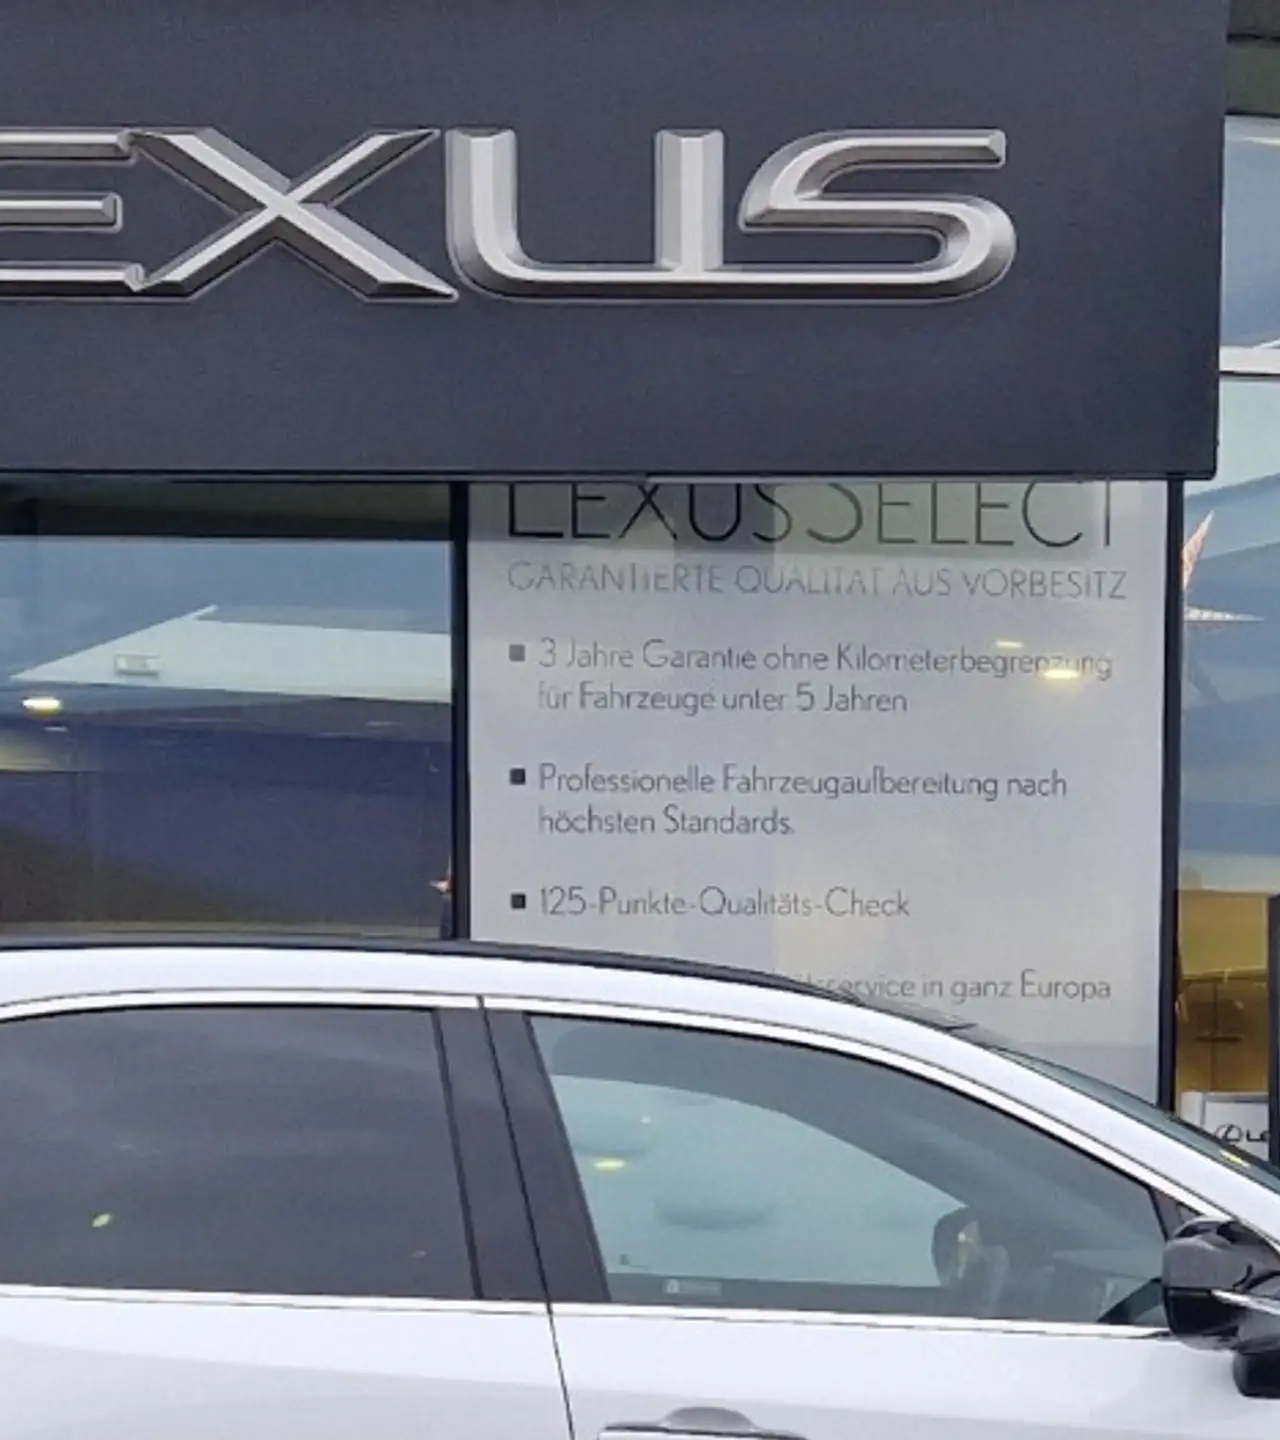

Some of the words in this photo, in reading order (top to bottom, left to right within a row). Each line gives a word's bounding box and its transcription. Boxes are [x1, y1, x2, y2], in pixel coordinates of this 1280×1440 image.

[507, 561, 723, 593] GARANTIERTE
[892, 566, 951, 597] AUS
[961, 568, 1128, 600] VORBESITZ
[538, 637, 557, 667] 3
[567, 641, 633, 668] Jahre
[642, 638, 756, 670] Garantie
[763, 644, 829, 671] ohne
[837, 643, 1112, 681] Kilometerbegrenzung
[579, 681, 715, 717] Fahrzeuge
[722, 688, 785, 712] unter
[795, 682, 815, 712] 5
[823, 685, 908, 713] Jahren
[539, 763, 715, 793] Professionelle
[722, 763, 998, 800] Fahrzeugaufbereitung
[1006, 769, 1067, 797] nach
[538, 803, 655, 834] höchsten
[663, 803, 795, 835] Standards.
[922, 973, 943, 998] in
[950, 979, 1012, 1003] ganz
[1020, 969, 1111, 1003] Europa
